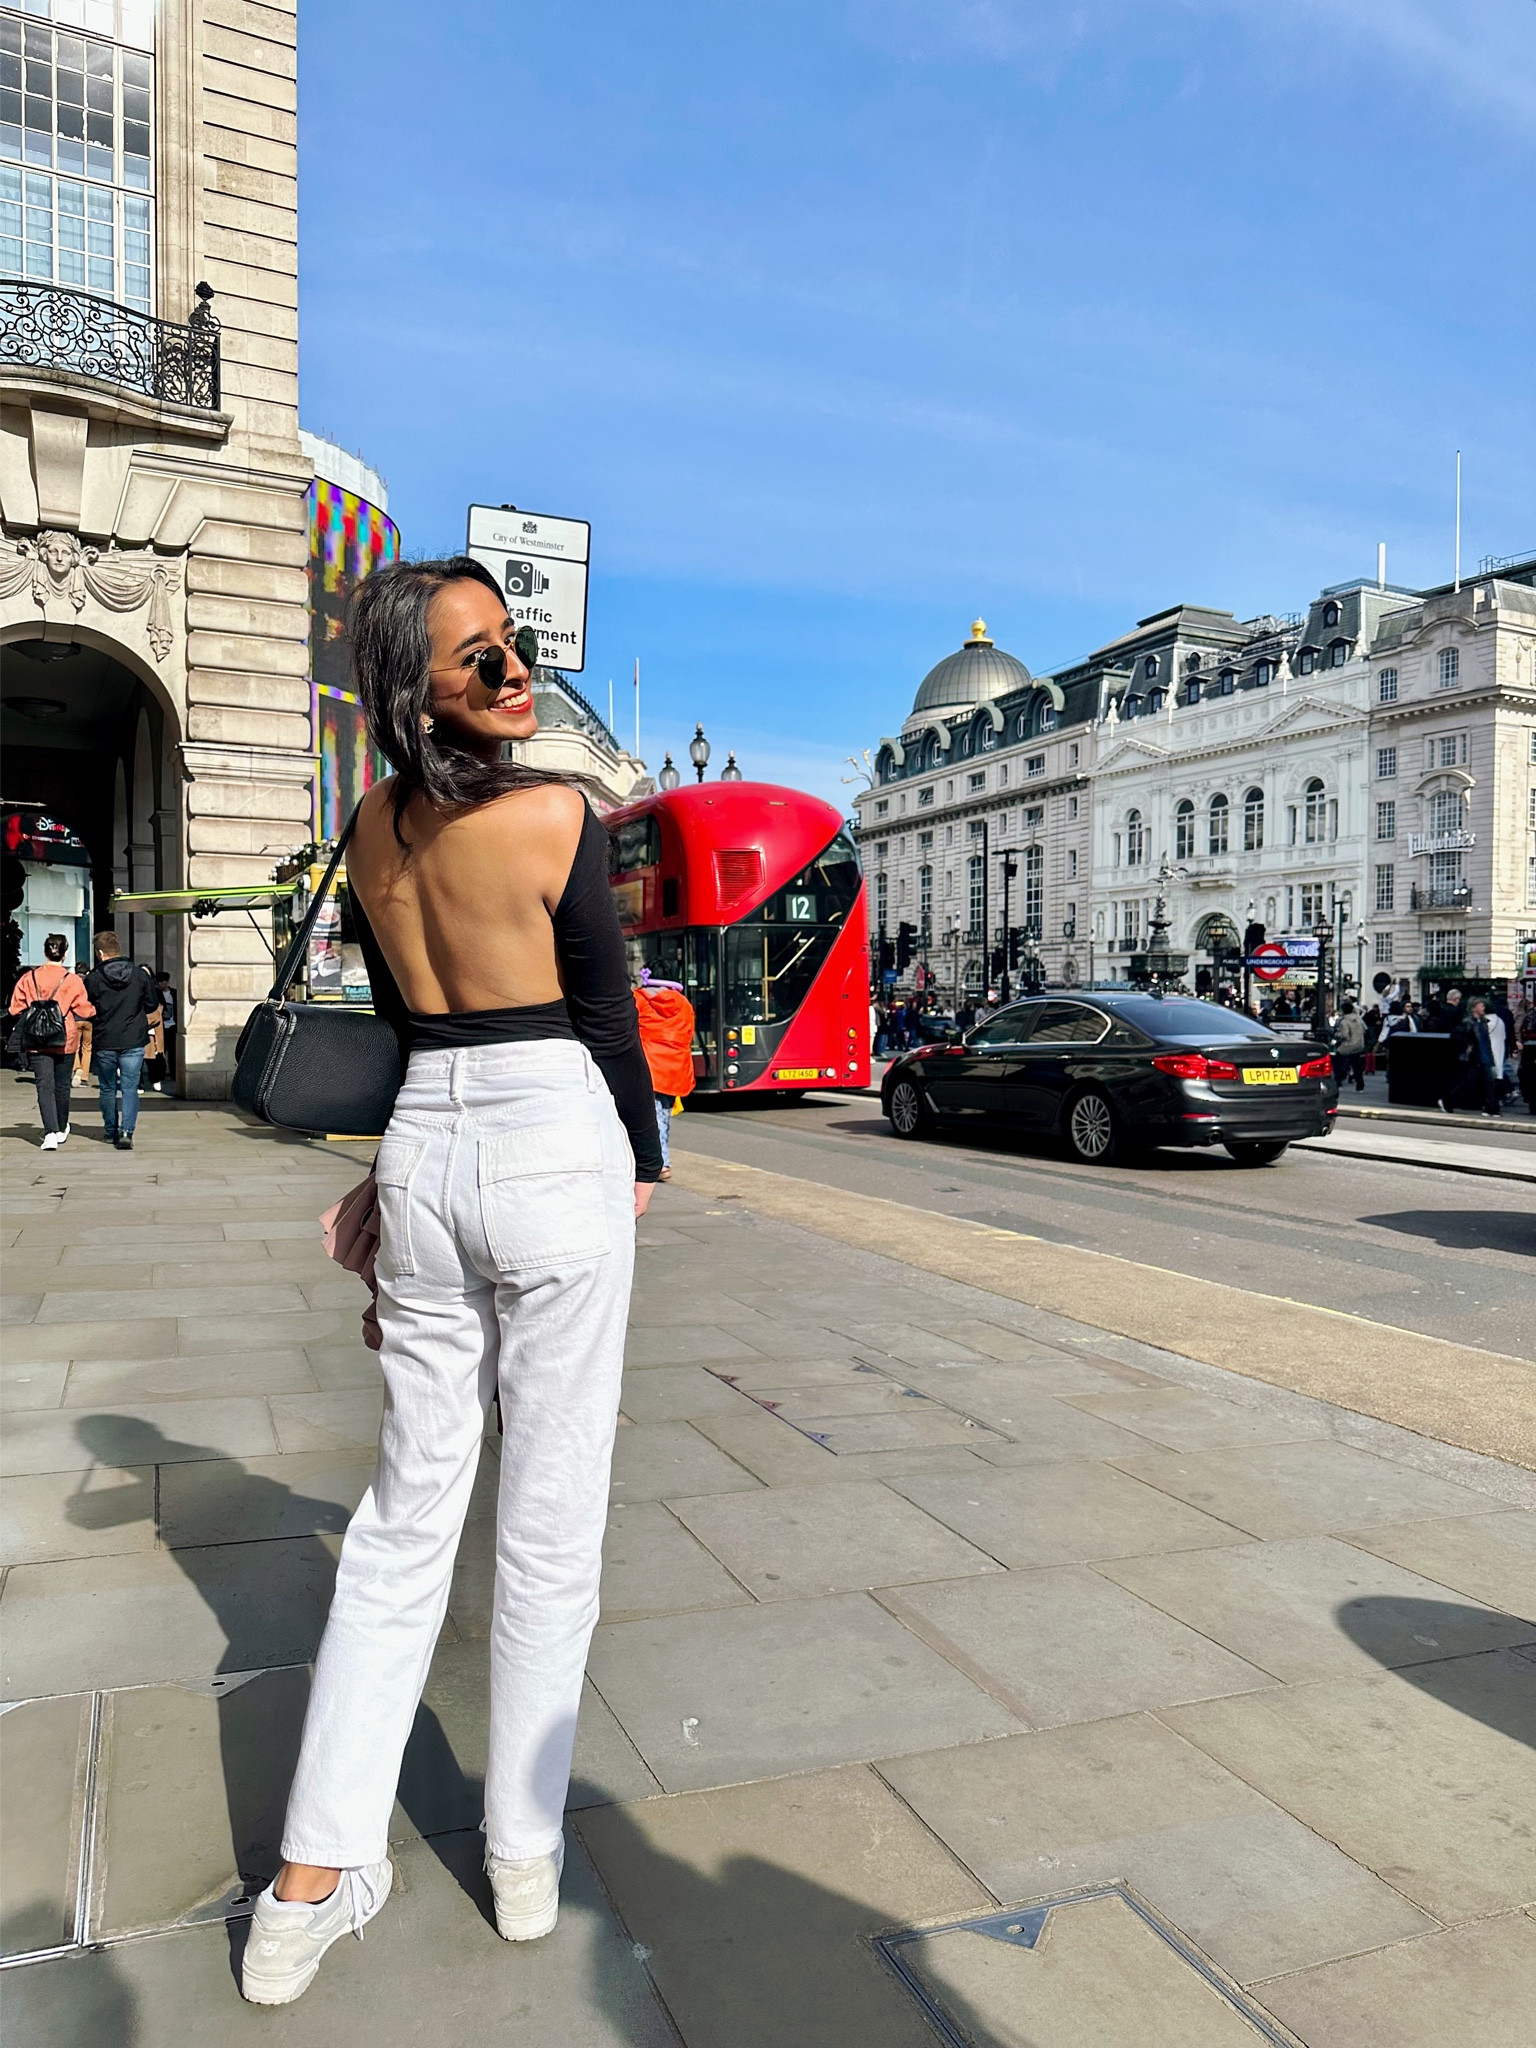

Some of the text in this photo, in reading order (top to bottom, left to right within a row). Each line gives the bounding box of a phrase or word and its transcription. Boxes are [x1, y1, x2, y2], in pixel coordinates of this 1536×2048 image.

[493, 533, 565, 551] City of Westminster
[509, 607, 552, 623] raffic
[36, 817, 70, 837] Disney
[792, 896, 811, 919] 12
[1246, 958, 1296, 966] UNDERGROUND
[1249, 1070, 1292, 1082] LP17 FZH
